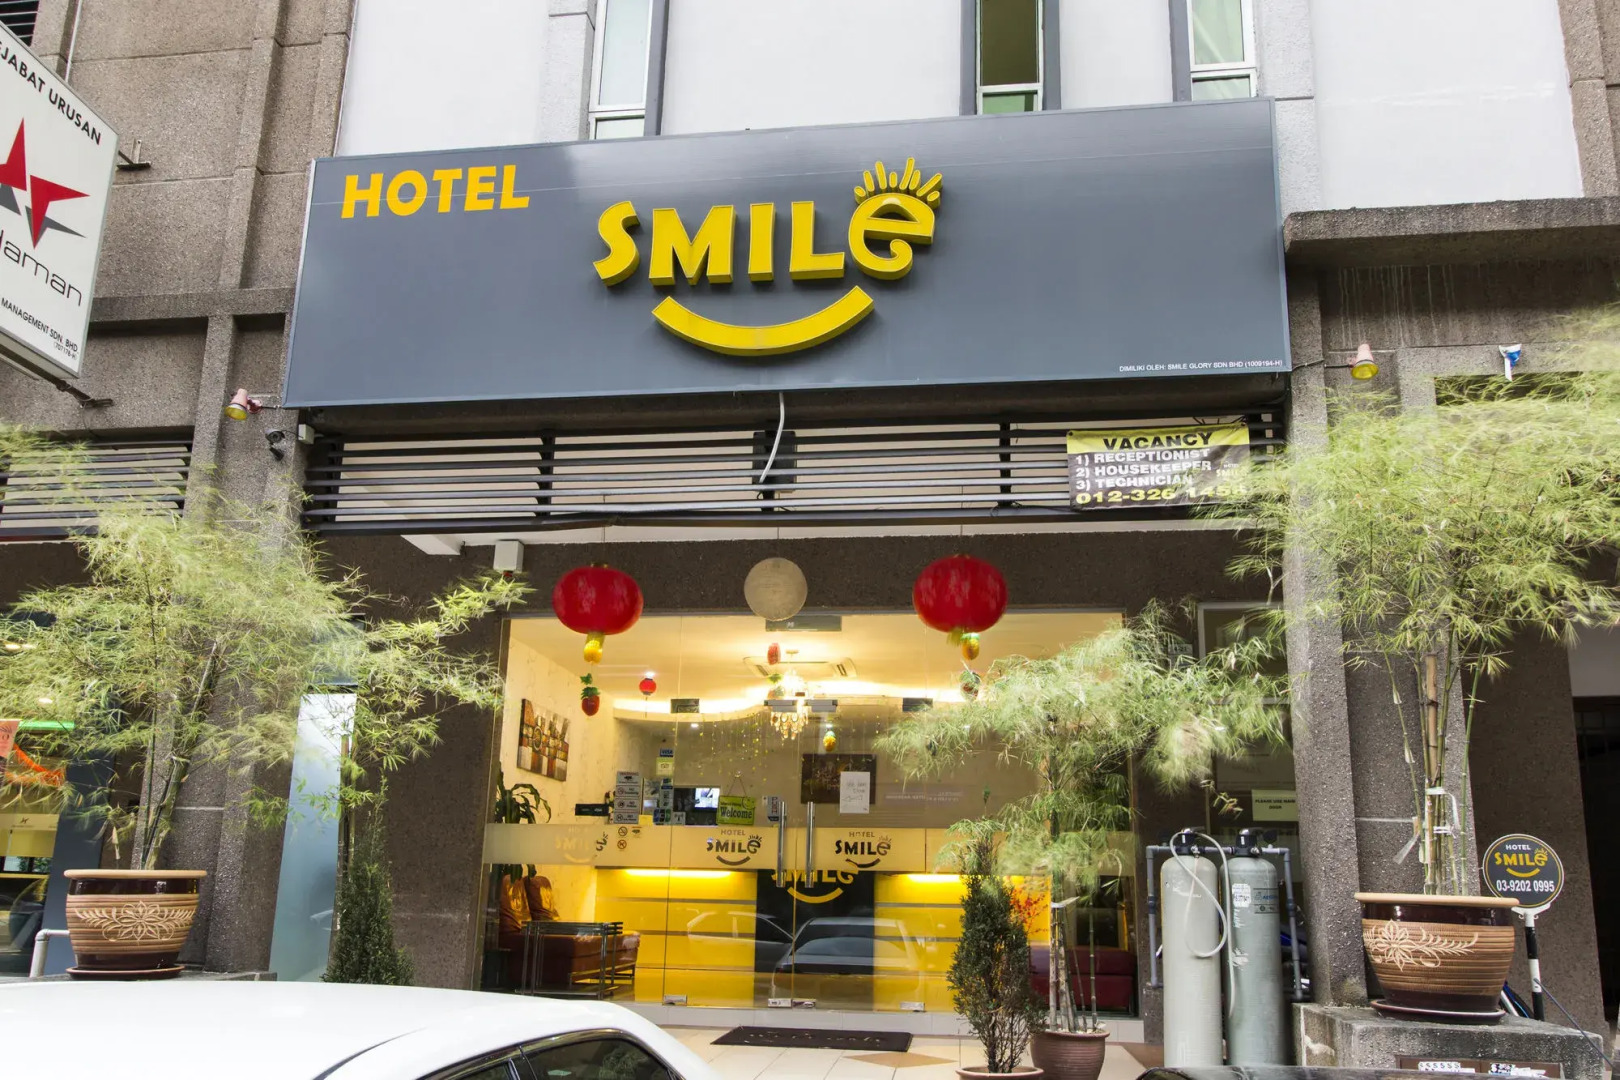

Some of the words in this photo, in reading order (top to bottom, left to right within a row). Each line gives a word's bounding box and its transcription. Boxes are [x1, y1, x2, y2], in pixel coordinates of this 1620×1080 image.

[0, 41, 46, 93] JABAT
[48, 88, 101, 145] URUSAN
[341, 164, 530, 219] HOTEL
[0, 230, 82, 306] aman
[1, 297, 50, 334] MANAGEMENT
[1119, 364, 1145, 372] DIMILIKI
[1167, 362, 1188, 370] SMILE
[1188, 361, 1212, 369] GLORY
[1213, 360, 1228, 368] SDN
[1228, 360, 1243, 368] BHD
[1103, 432, 1213, 450] VACANCY
[1075, 455, 1089, 466] 1)
[1094, 448, 1211, 463] RECEPTIONIST
[1075, 467, 1090, 478] 2)
[1094, 460, 1212, 477] HOUSEKEEPER
[1075, 479, 1091, 491] 3)
[1095, 474, 1193, 489] TECHNICIAN
[1075, 488, 1176, 505] 012-326
[720, 806, 753, 819] Welcome
[1496, 879, 1531, 892] 03-9202
[1533, 880, 1555, 892] 0995
